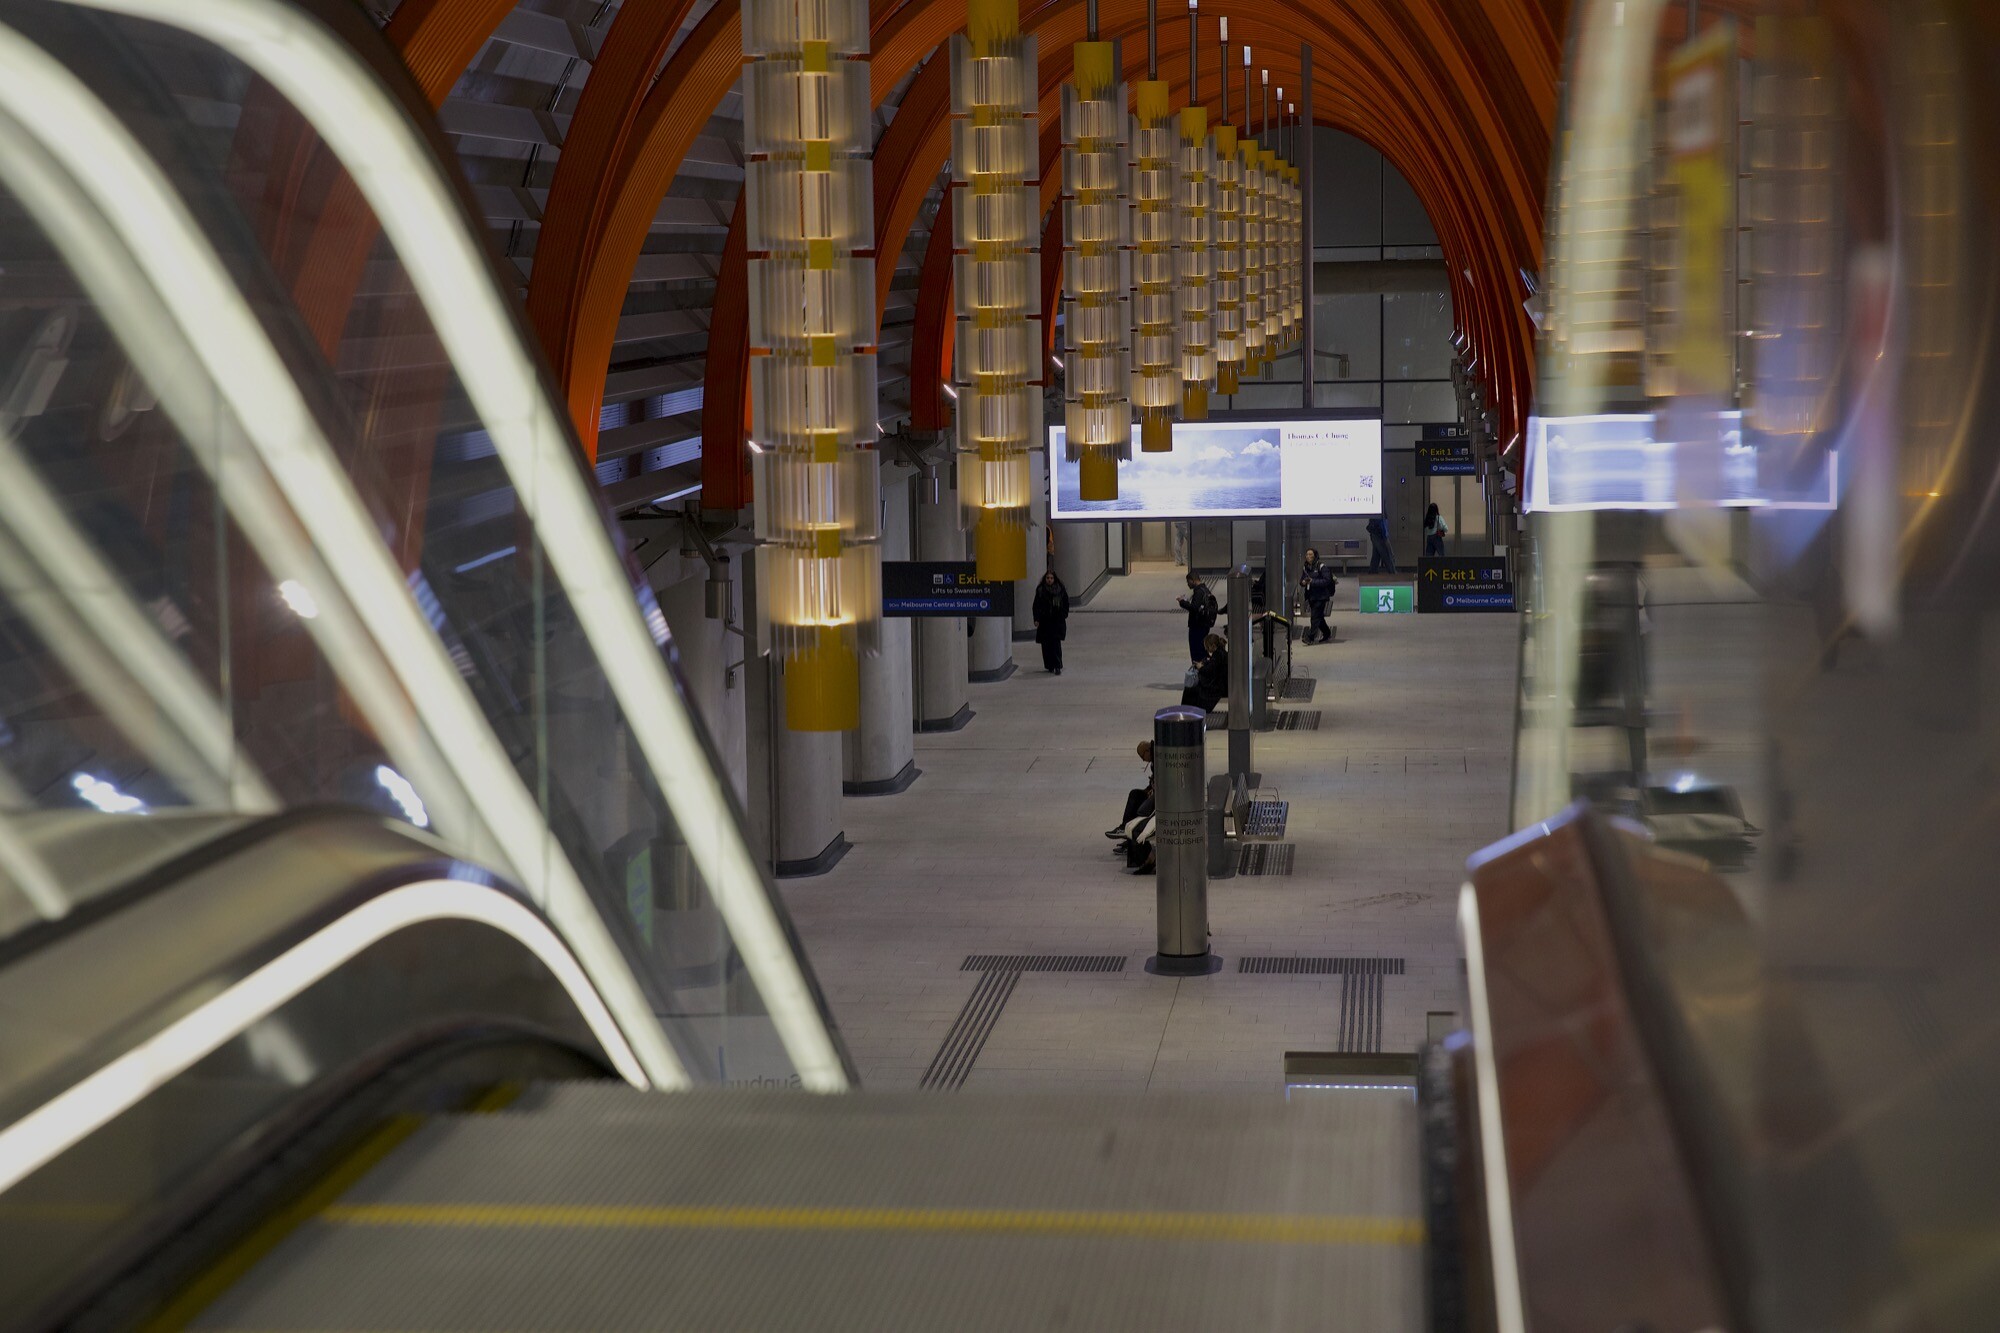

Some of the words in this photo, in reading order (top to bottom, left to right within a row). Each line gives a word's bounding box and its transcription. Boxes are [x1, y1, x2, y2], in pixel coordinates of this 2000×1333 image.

[1430, 447, 1446, 456] Exit
[1447, 448, 1451, 456] 1
[1442, 569, 1466, 581] Exit
[1469, 569, 1476, 581] 1
[1170, 817, 1203, 827] HYDRANT
[1162, 828, 1178, 836] AND
[1179, 828, 1197, 836] FIRE
